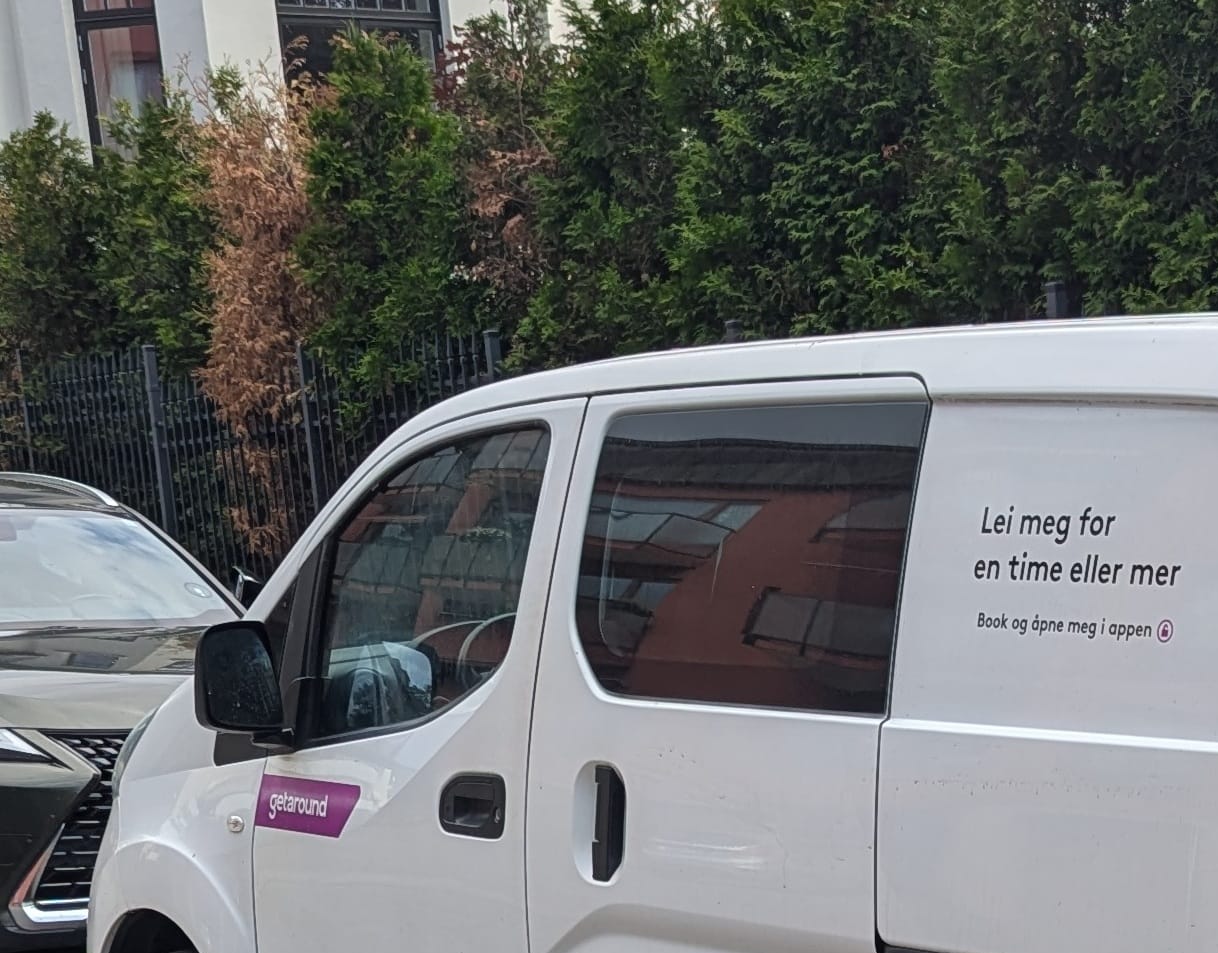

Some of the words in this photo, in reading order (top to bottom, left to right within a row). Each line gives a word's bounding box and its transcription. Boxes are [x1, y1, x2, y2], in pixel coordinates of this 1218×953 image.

[981, 505, 1014, 534] Lei
[1019, 514, 1071, 545] meg
[1079, 506, 1116, 536] for
[974, 559, 1000, 580] en
[1008, 551, 1063, 582] time
[1069, 554, 1123, 584] eller
[1129, 563, 1182, 586] mer
[977, 612, 1009, 630] Book
[1011, 617, 1028, 635] og
[1031, 614, 1064, 636] åpne
[1067, 619, 1097, 639] meg
[1100, 618, 1106, 635] i
[1108, 622, 1152, 641] appen
[269, 791, 329, 820] getaround
